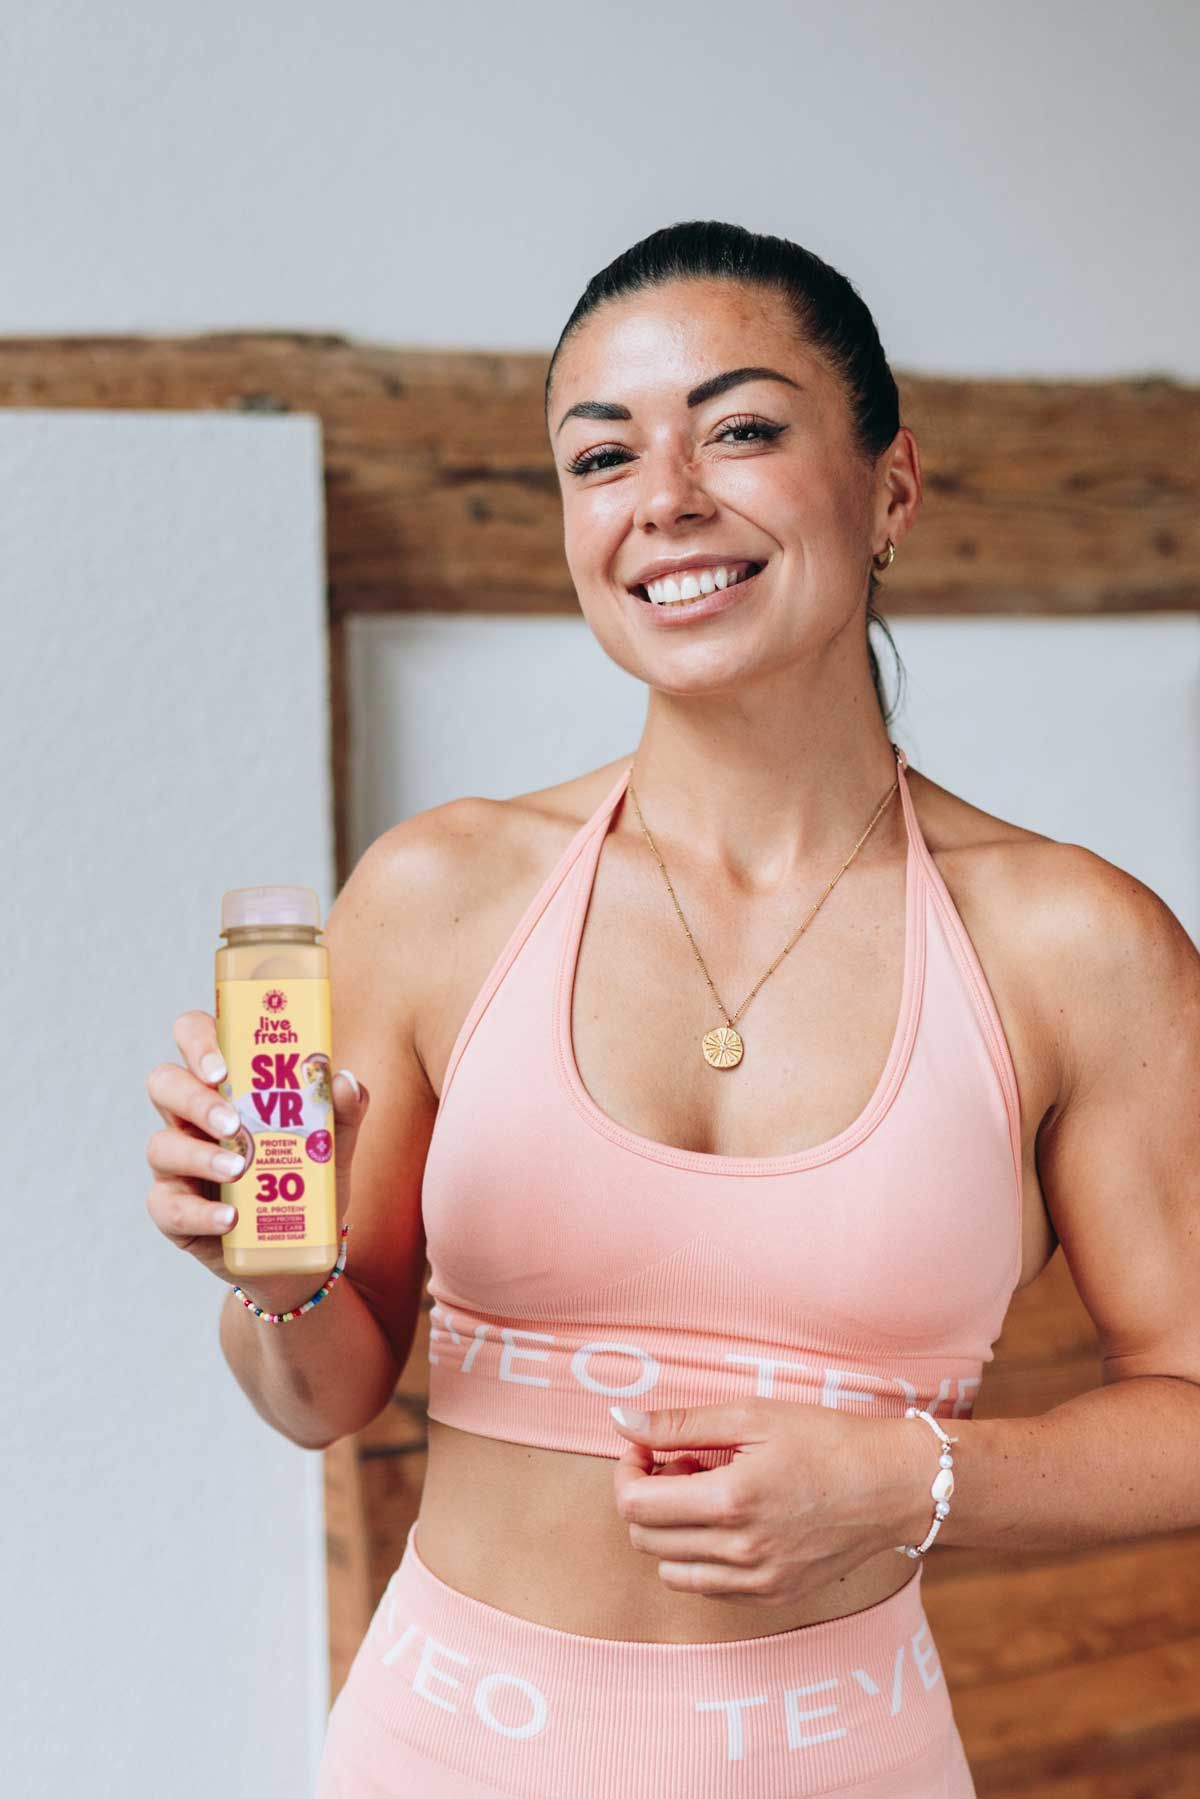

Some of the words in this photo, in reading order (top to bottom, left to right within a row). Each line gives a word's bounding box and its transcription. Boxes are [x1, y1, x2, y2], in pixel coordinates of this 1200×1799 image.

[259, 1016, 291, 1031] live
[254, 1029, 298, 1045] fresh
[251, 1053, 300, 1090] SK
[251, 1091, 304, 1128] YR
[260, 1139, 297, 1148] PROTEIN
[255, 1157, 303, 1165] MARACUJA
[255, 1172, 305, 1203] 30
